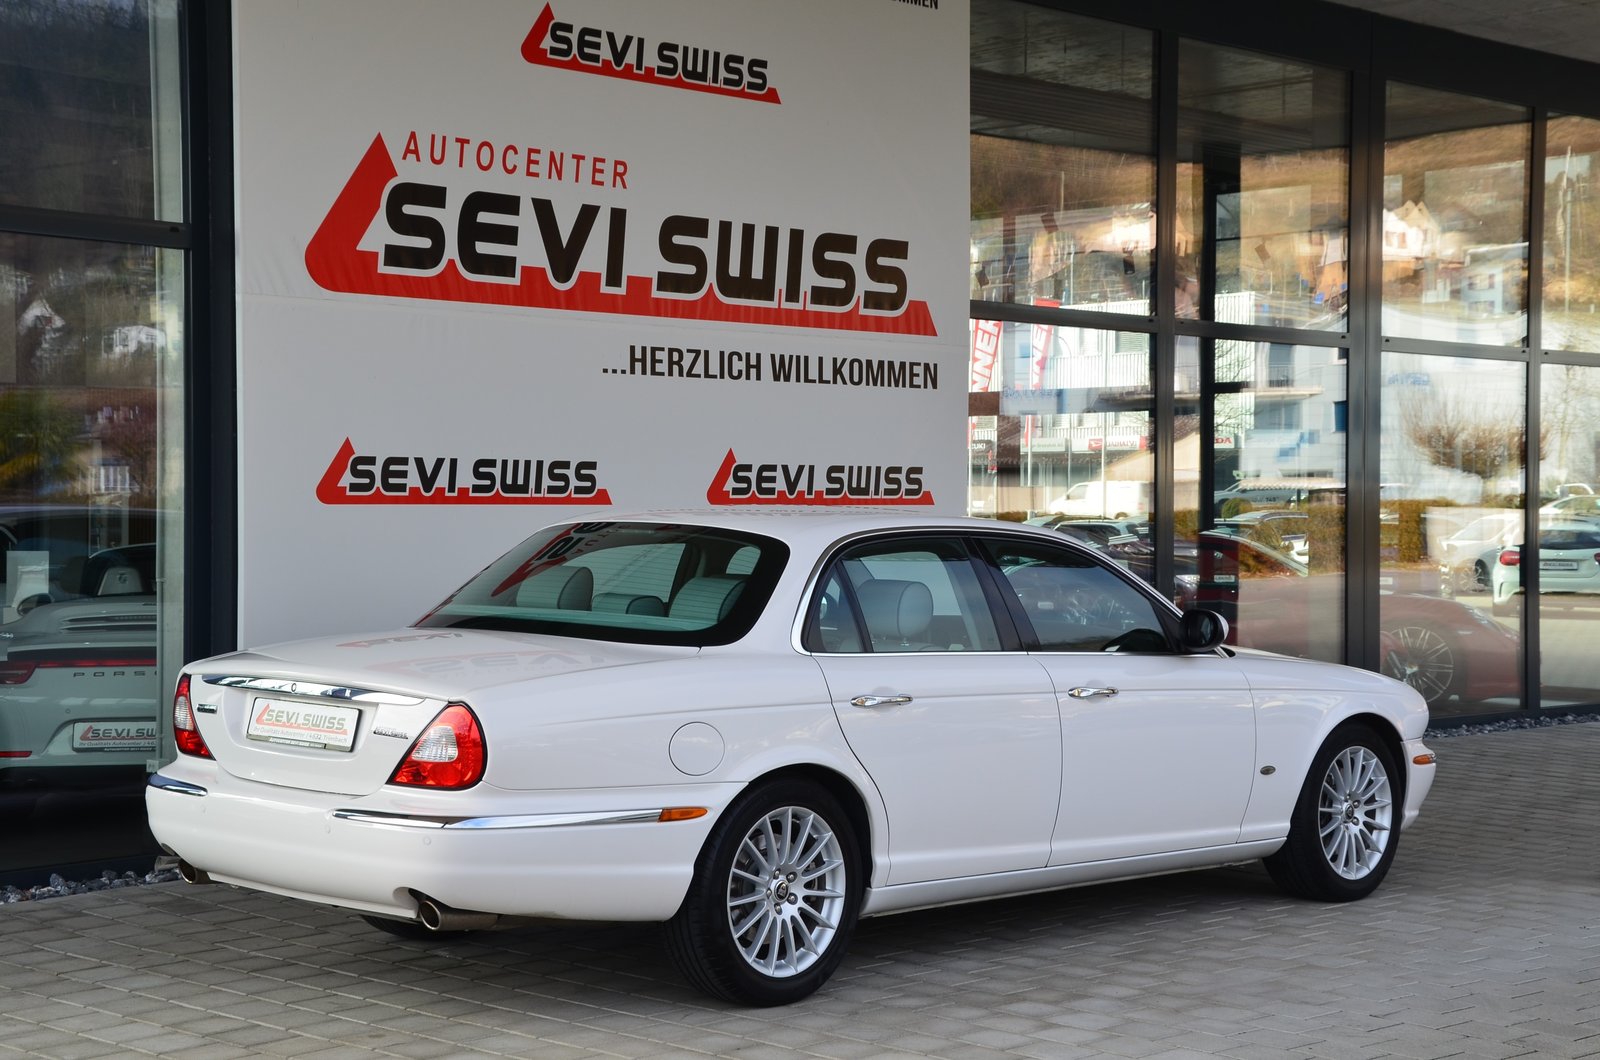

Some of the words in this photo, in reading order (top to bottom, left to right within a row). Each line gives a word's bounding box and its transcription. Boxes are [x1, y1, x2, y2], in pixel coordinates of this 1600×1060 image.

[550, 22, 645, 71] SEVI
[657, 42, 769, 92] SWISS
[402, 131, 629, 189] AUTOCENTER
[383, 181, 627, 289] SEVI
[656, 214, 909, 312] SWISS
[769, 353, 938, 390] WILLKOMMEN
[348, 455, 458, 493] SEVI
[471, 458, 598, 495] SWISS
[731, 463, 815, 497] SEVI
[825, 465, 924, 497] SWISS
[91, 728, 131, 738] SEVI
[265, 709, 300, 725] SEVI
[302, 713, 346, 730] SWISS
